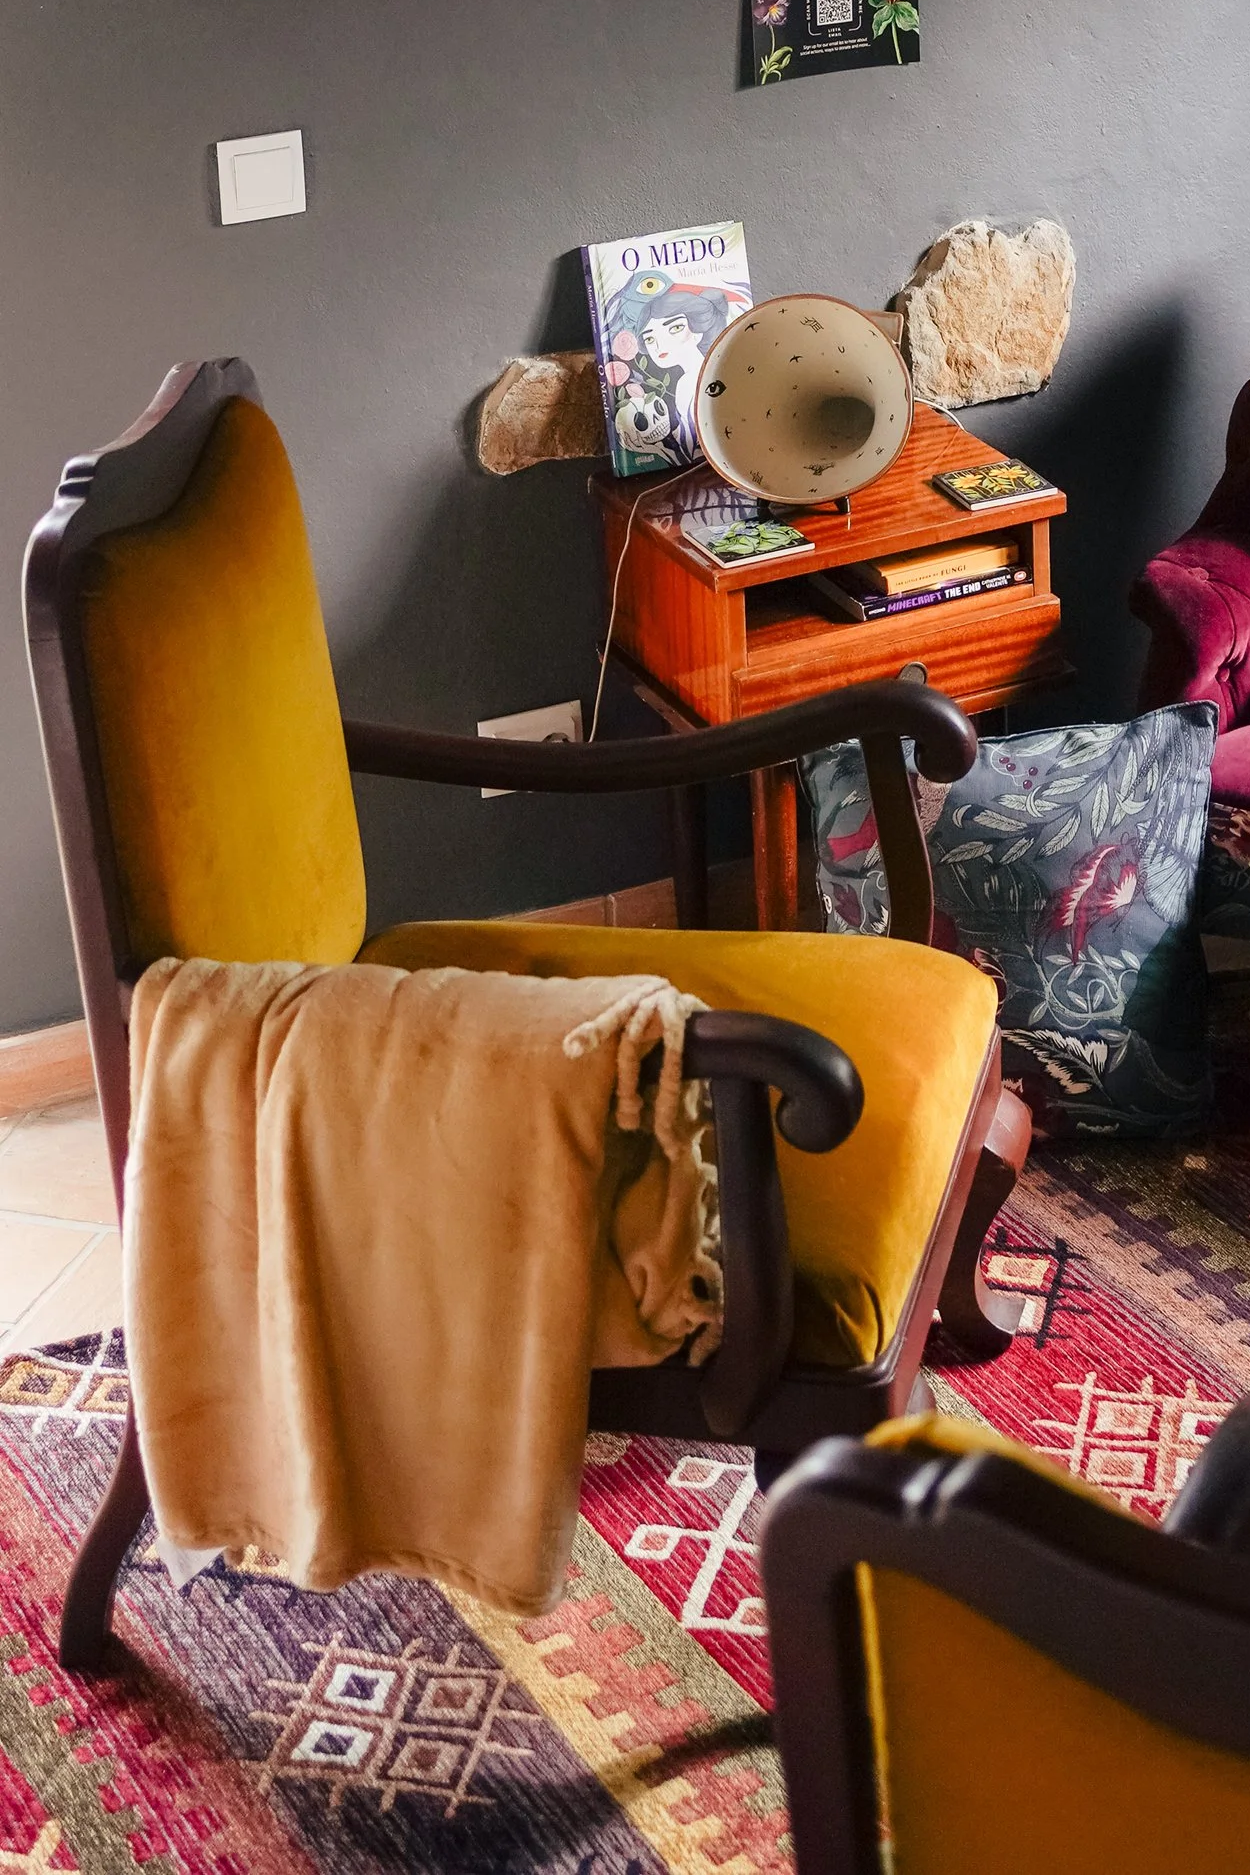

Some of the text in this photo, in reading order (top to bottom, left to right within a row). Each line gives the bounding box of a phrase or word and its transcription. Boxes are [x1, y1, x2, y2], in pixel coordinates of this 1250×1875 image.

[622, 235, 726, 271] O MEDO
[597, 364, 610, 419] O Medo
[940, 565, 967, 576] FUNGI
[986, 579, 1008, 589] VALENTE
[887, 591, 942, 613] MINECRAFT
[944, 587, 962, 599] THE
[962, 581, 982, 595] END
